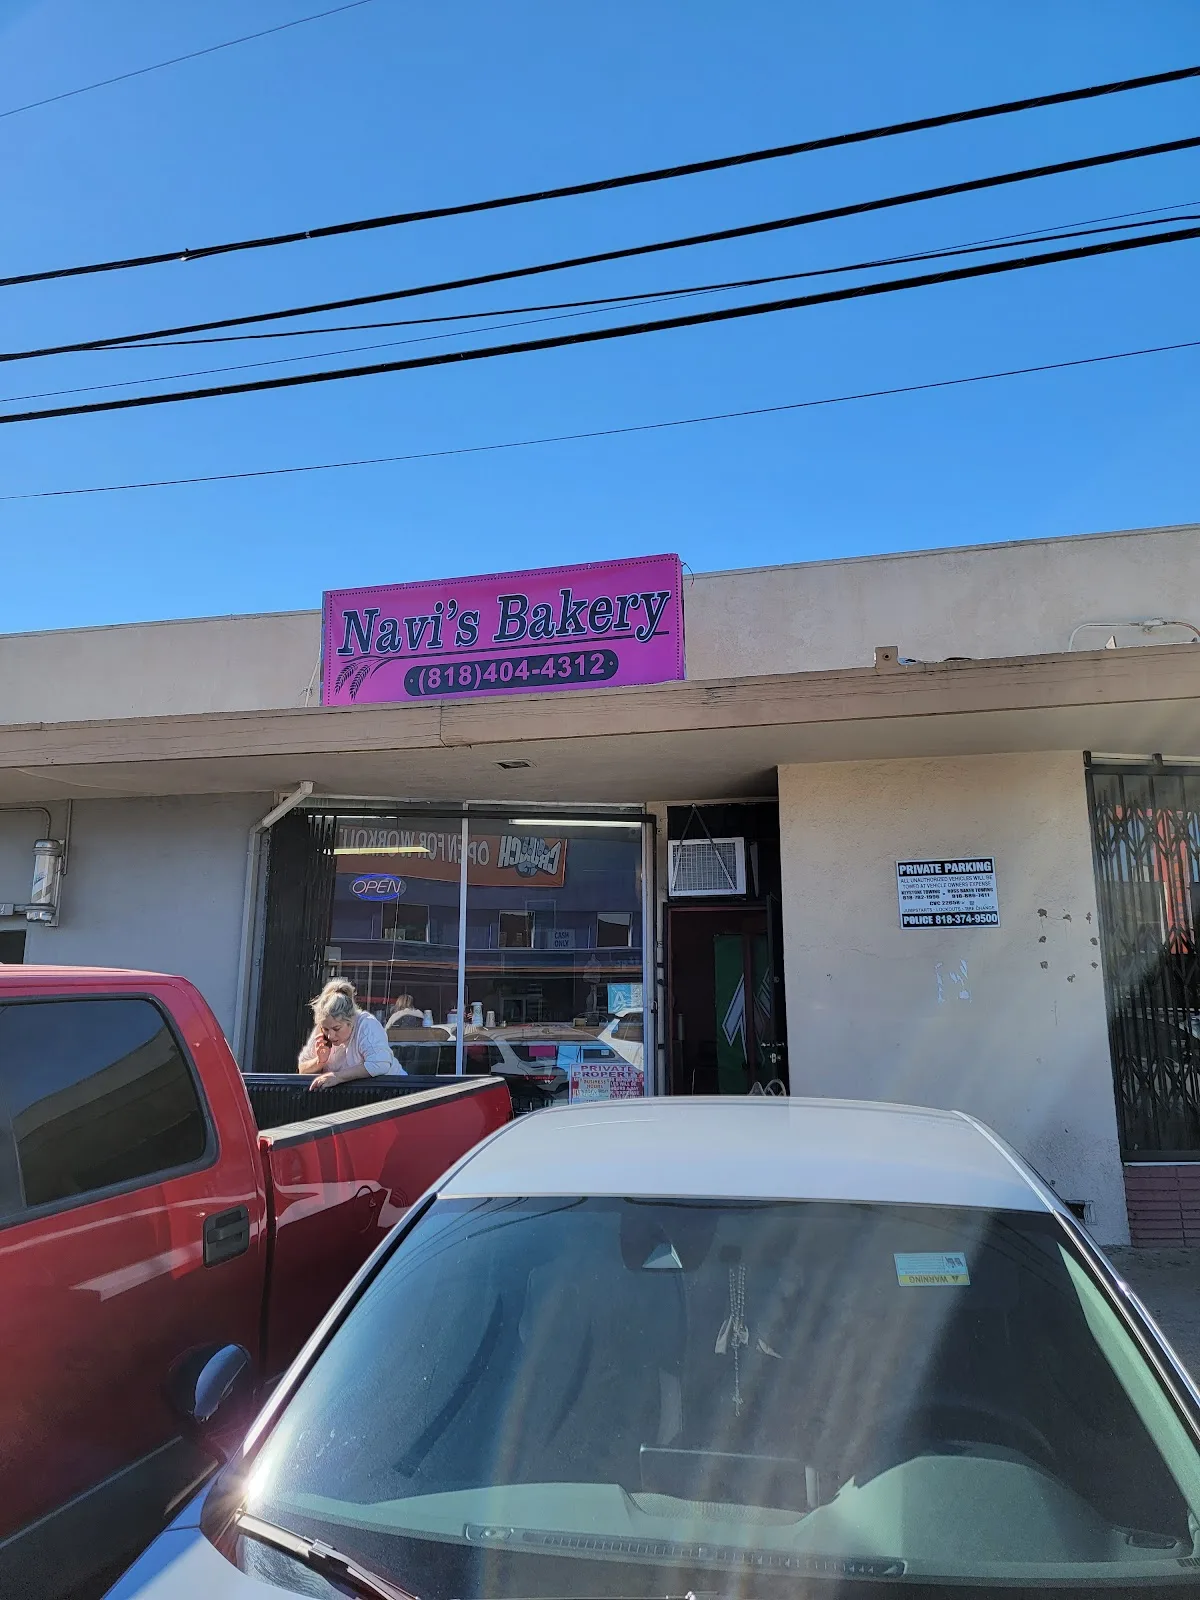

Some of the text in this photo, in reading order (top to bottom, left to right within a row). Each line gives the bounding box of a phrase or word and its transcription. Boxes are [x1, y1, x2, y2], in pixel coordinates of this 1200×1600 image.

[336, 587, 671, 656] Navi's Bakery
[418, 653, 605, 695] (818)404-4312
[899, 861, 992, 874] PRIVATE PARKING
[352, 880, 401, 894] OPEN
[903, 913, 998, 925] POLICE 818-374-9500
[554, 931, 570, 939] CASH
[554, 940, 569, 948] ONLY
